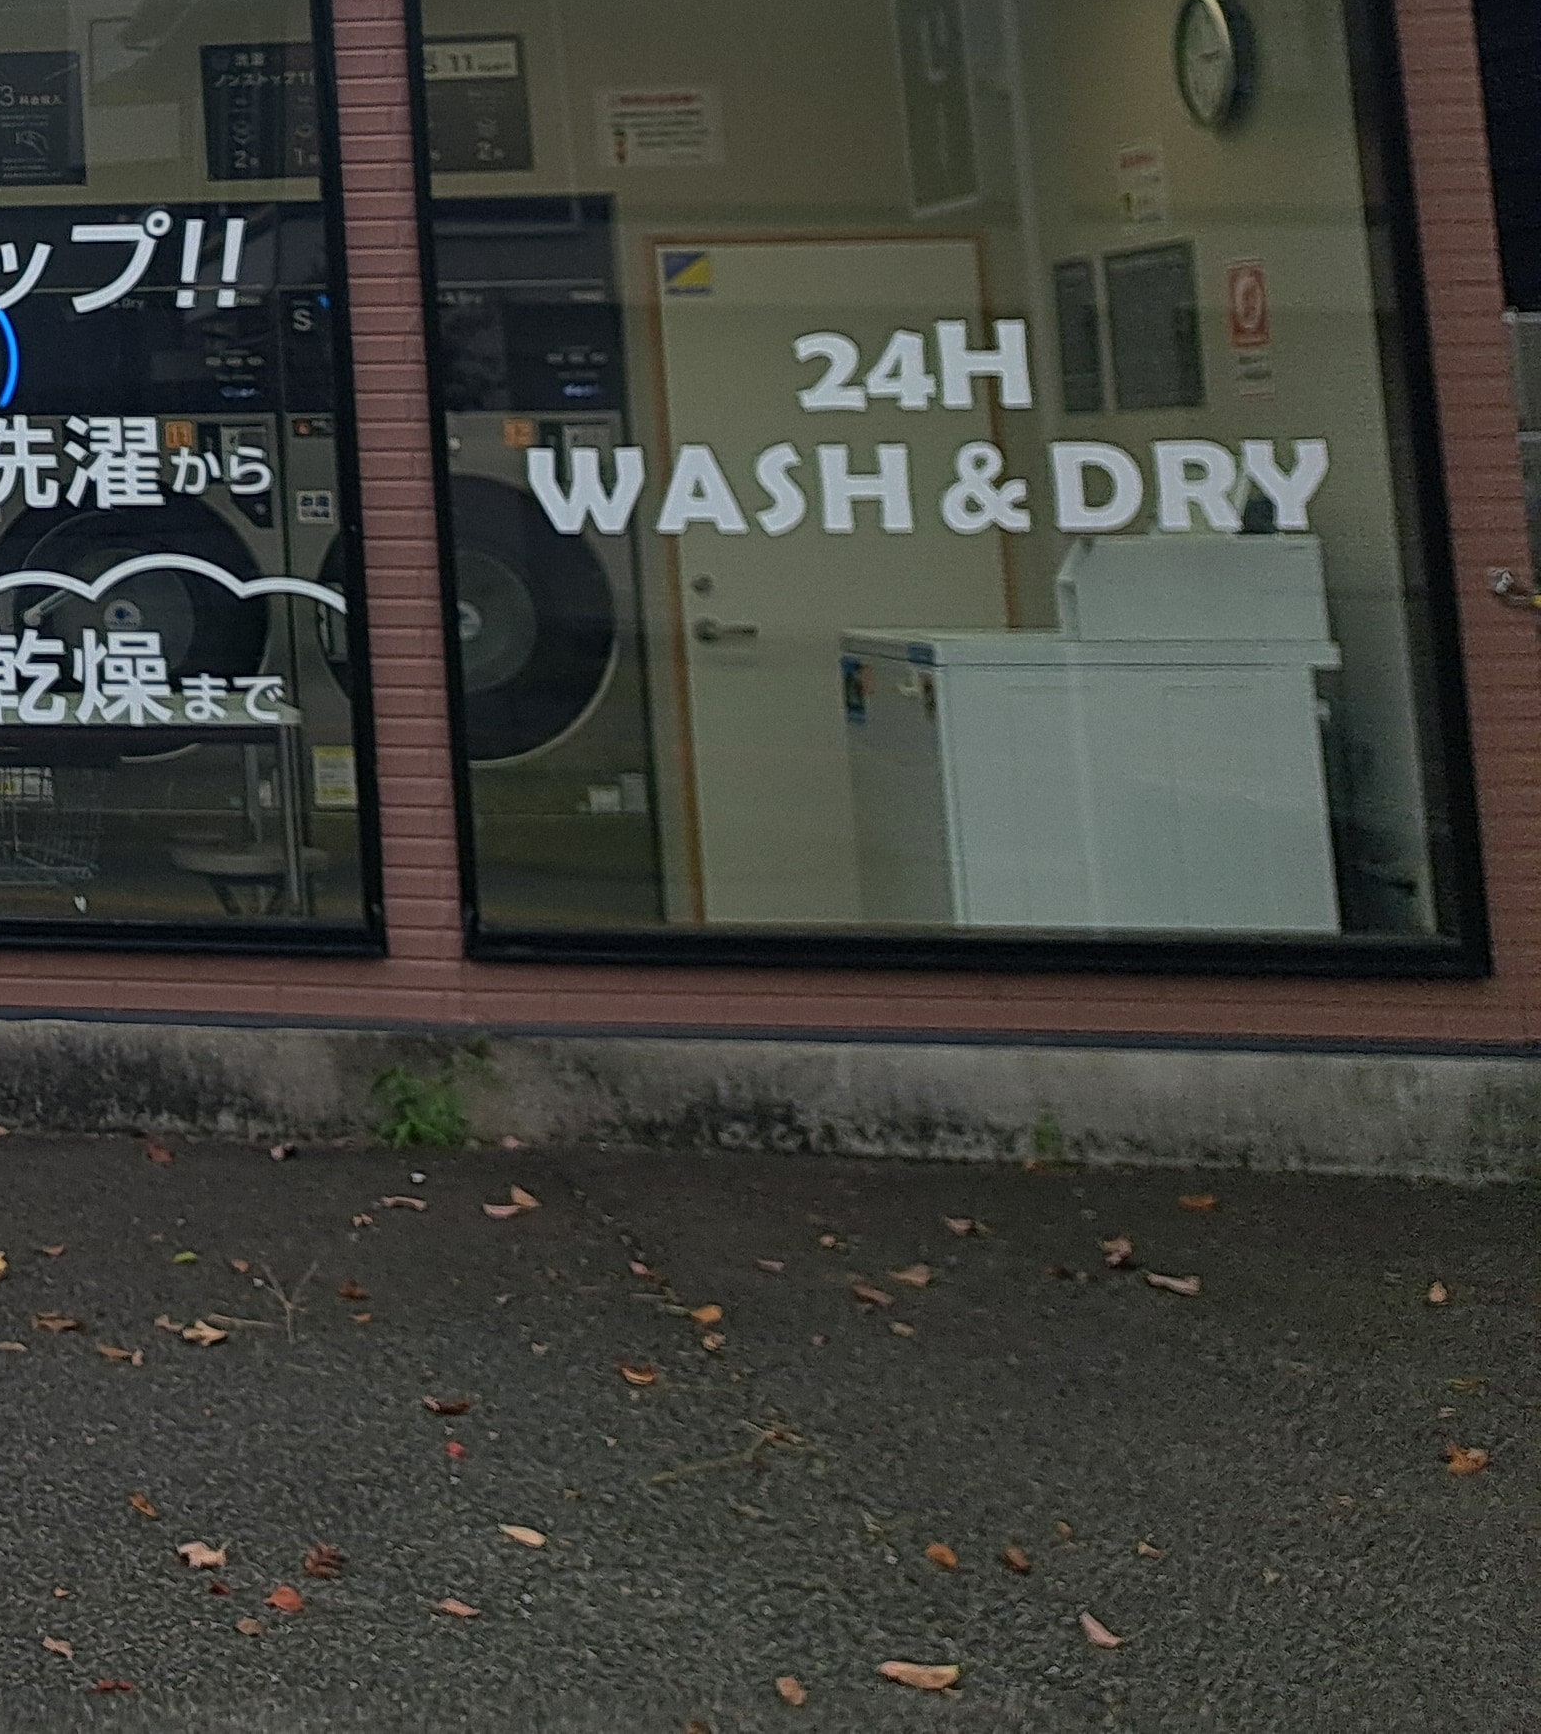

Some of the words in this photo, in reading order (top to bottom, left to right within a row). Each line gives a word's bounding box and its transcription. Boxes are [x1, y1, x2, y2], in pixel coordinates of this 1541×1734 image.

[292, 308, 313, 332] S
[793, 318, 1033, 413] 24H
[525, 441, 914, 537] WASH
[940, 441, 1032, 535] &
[1049, 438, 1330, 534] DRY
